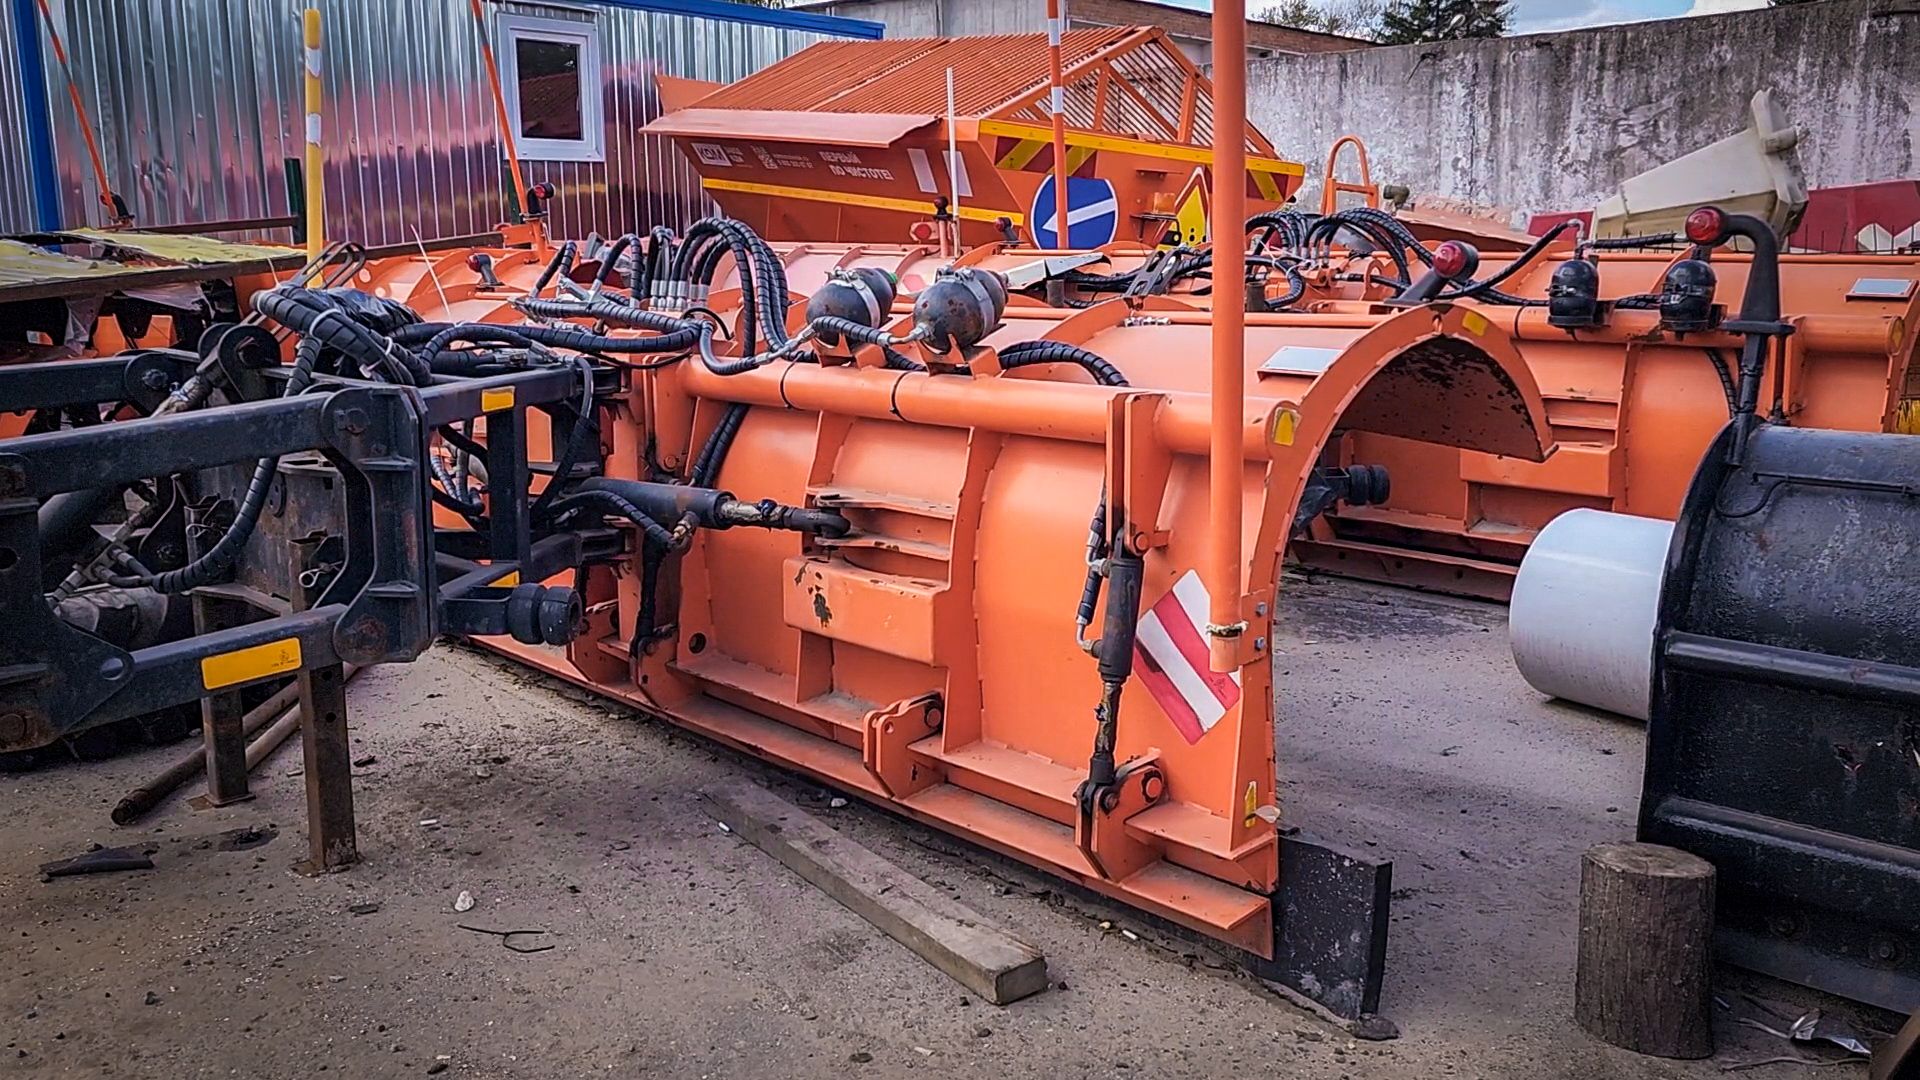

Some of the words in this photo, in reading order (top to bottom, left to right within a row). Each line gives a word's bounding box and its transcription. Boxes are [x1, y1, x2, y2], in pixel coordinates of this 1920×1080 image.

[818, 151, 862, 164] ПЕРВЫЙ
[829, 164, 846, 176] ПО
[843, 166, 895, 180] ЧИСТОТЕ!
